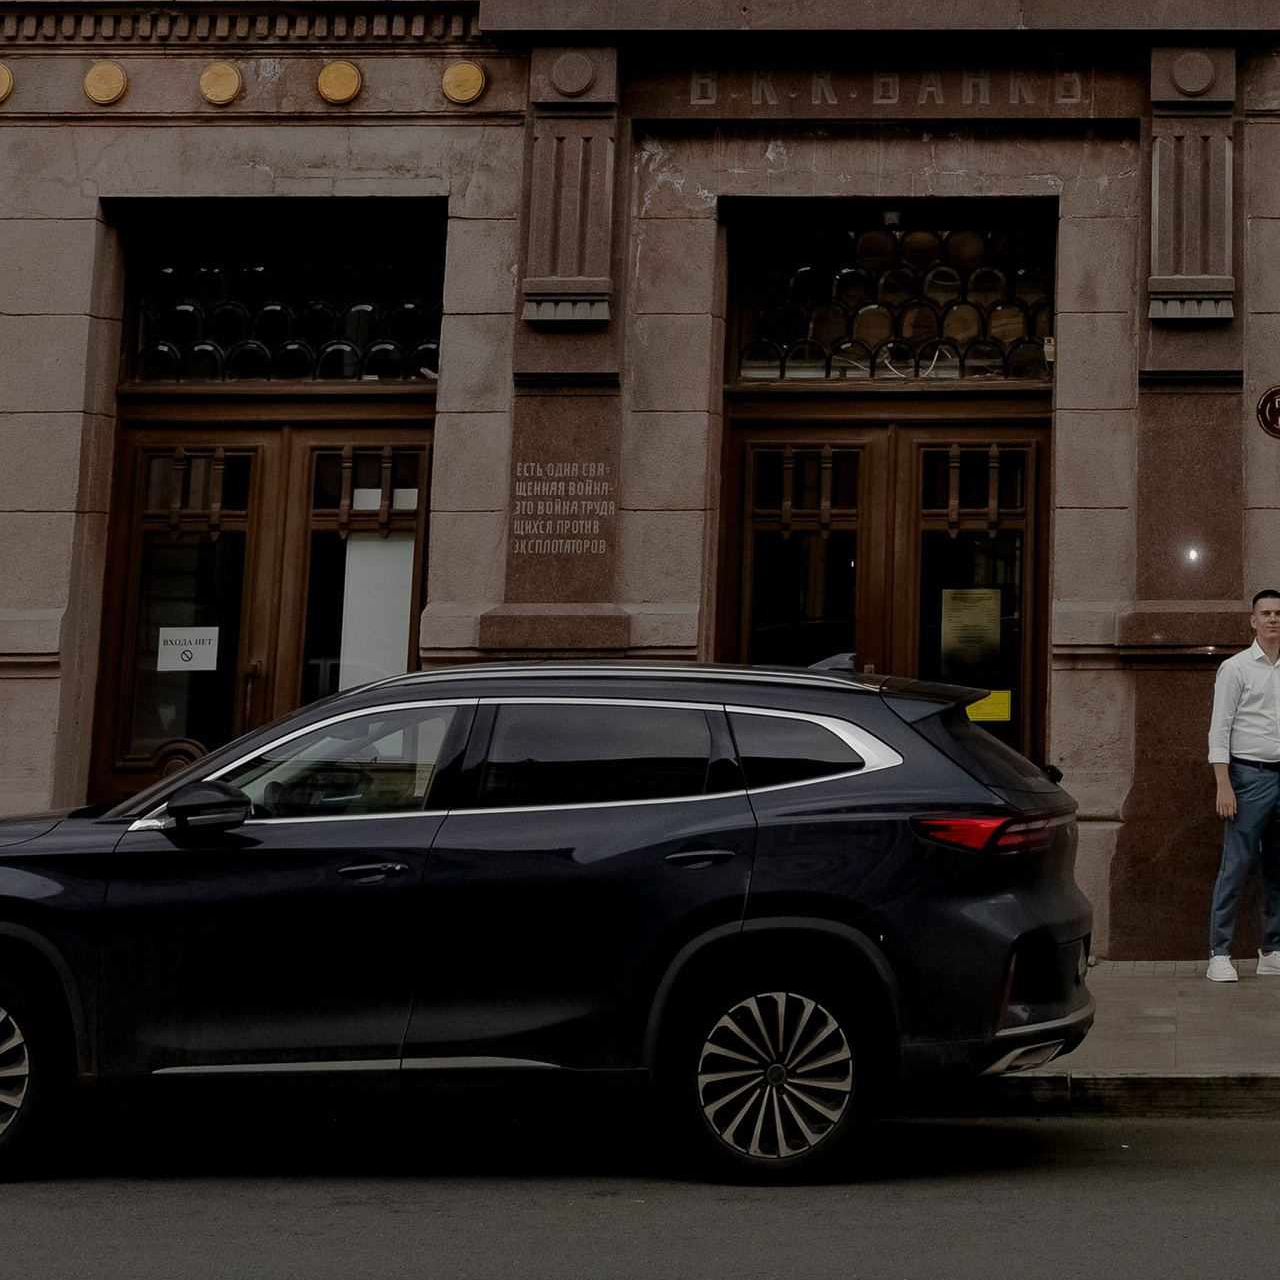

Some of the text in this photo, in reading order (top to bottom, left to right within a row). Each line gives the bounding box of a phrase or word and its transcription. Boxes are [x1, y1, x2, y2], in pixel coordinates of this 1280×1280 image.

[517, 462, 543, 477] ЕСТЬ
[547, 462, 579, 478] ОДНА
[515, 481, 565, 497] ЩЕННАЯ
[515, 501, 534, 515] ЭТО
[537, 499, 579, 515] ВОЙНА
[514, 520, 600, 536] ЩИХСЯ ПРОТИВ
[163, 638, 213, 646] ВХОДА НЕТ
